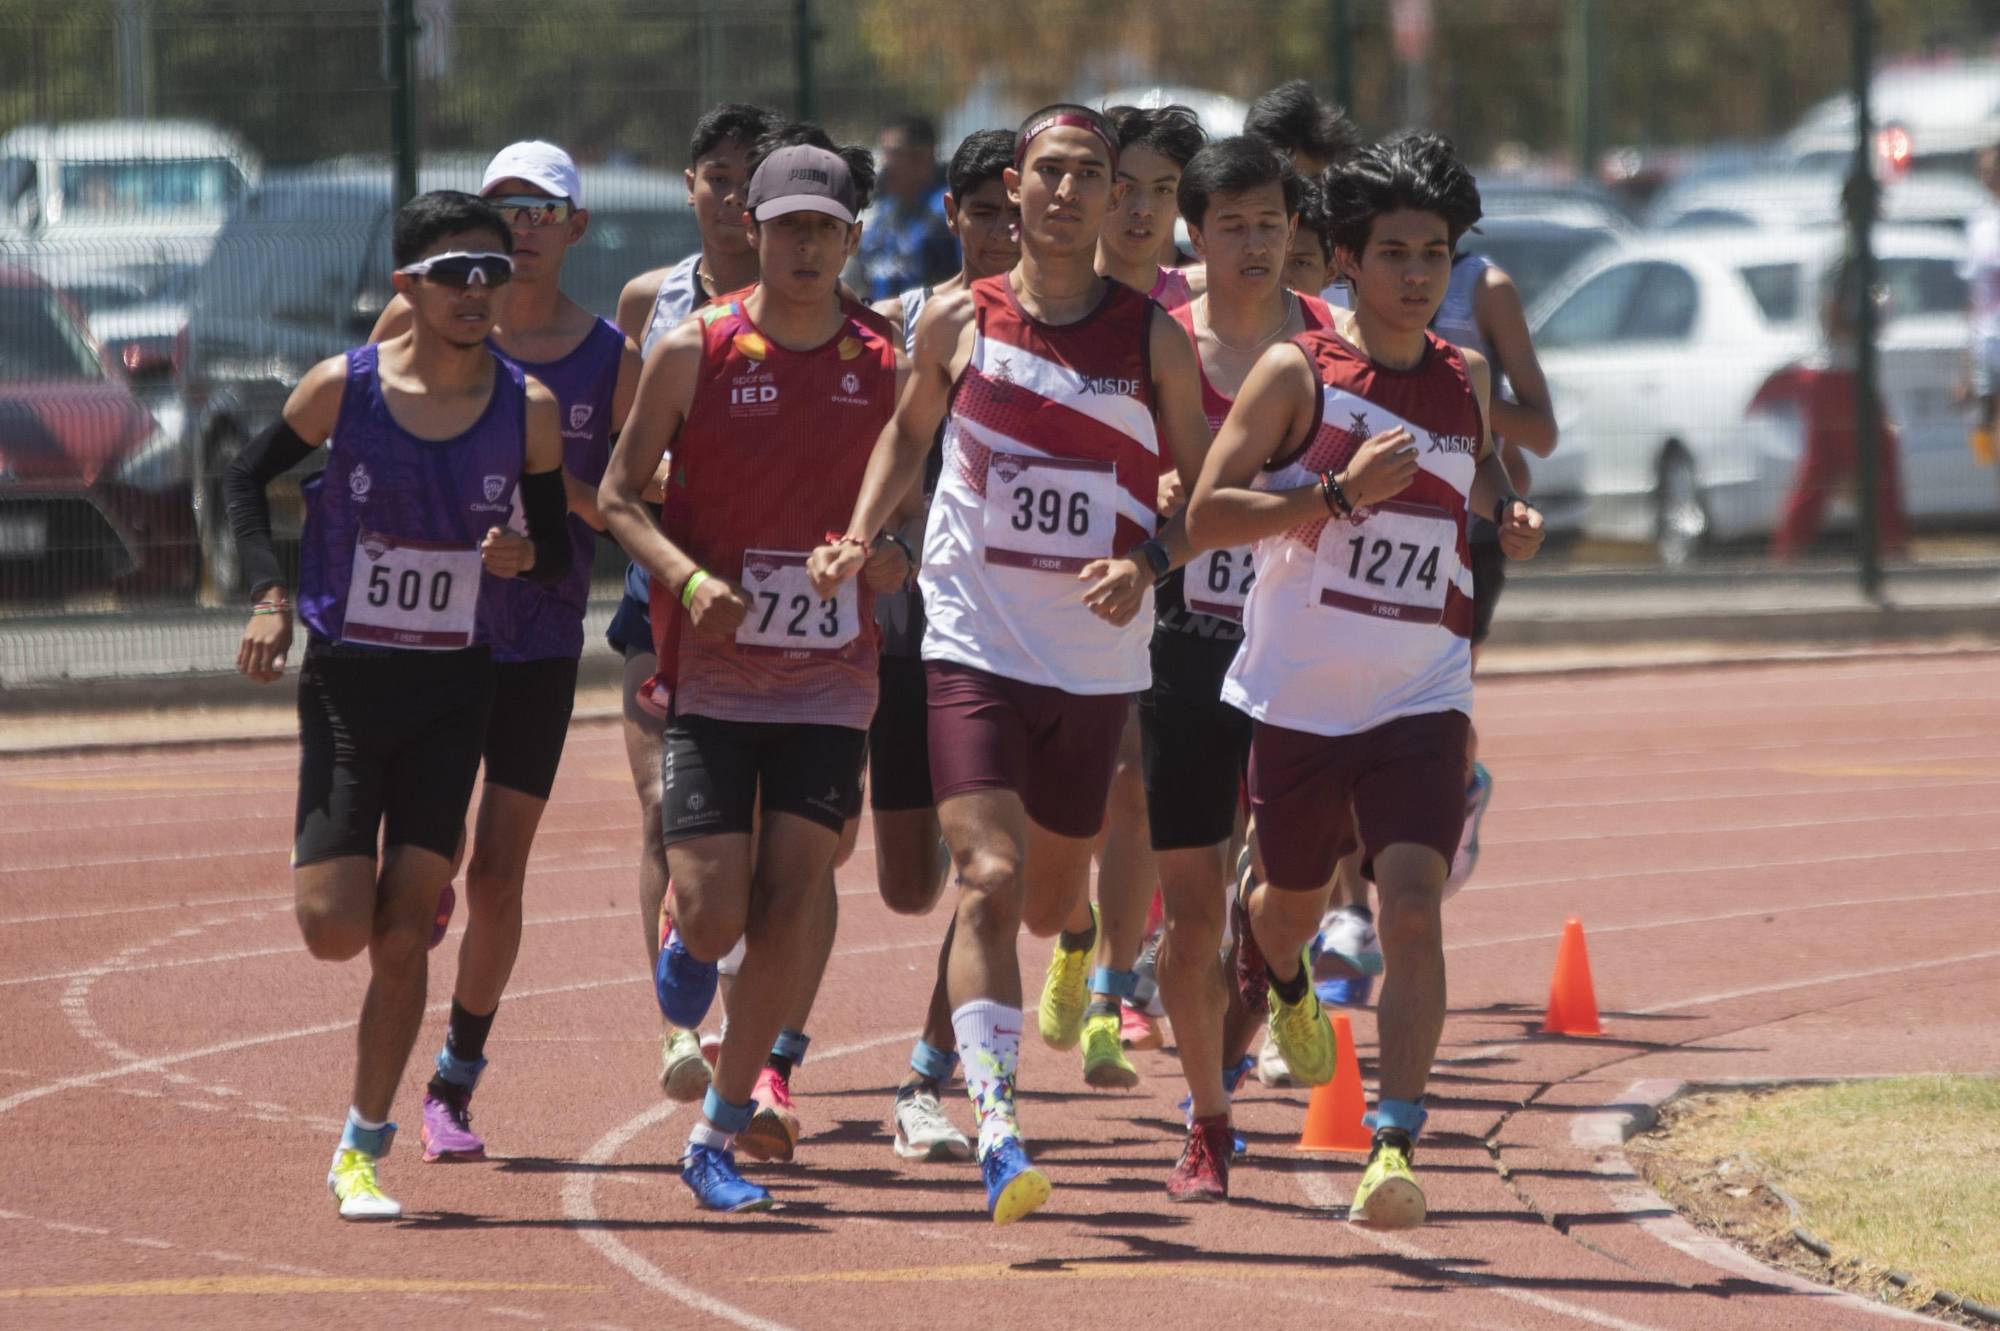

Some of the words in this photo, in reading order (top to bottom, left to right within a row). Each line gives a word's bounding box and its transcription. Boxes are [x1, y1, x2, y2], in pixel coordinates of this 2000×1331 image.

[731, 386, 779, 404] IED
[1098, 378, 1140, 396] ISDE
[1446, 435, 1477, 454] ISDE
[1011, 487, 1090, 536] 396
[1039, 559, 1062, 570] ISDE
[1207, 550, 1255, 593] 62
[1348, 536, 1441, 591] 1274
[367, 565, 453, 611] 500
[757, 592, 839, 638] 723
[1377, 606, 1401, 617] ISDE
